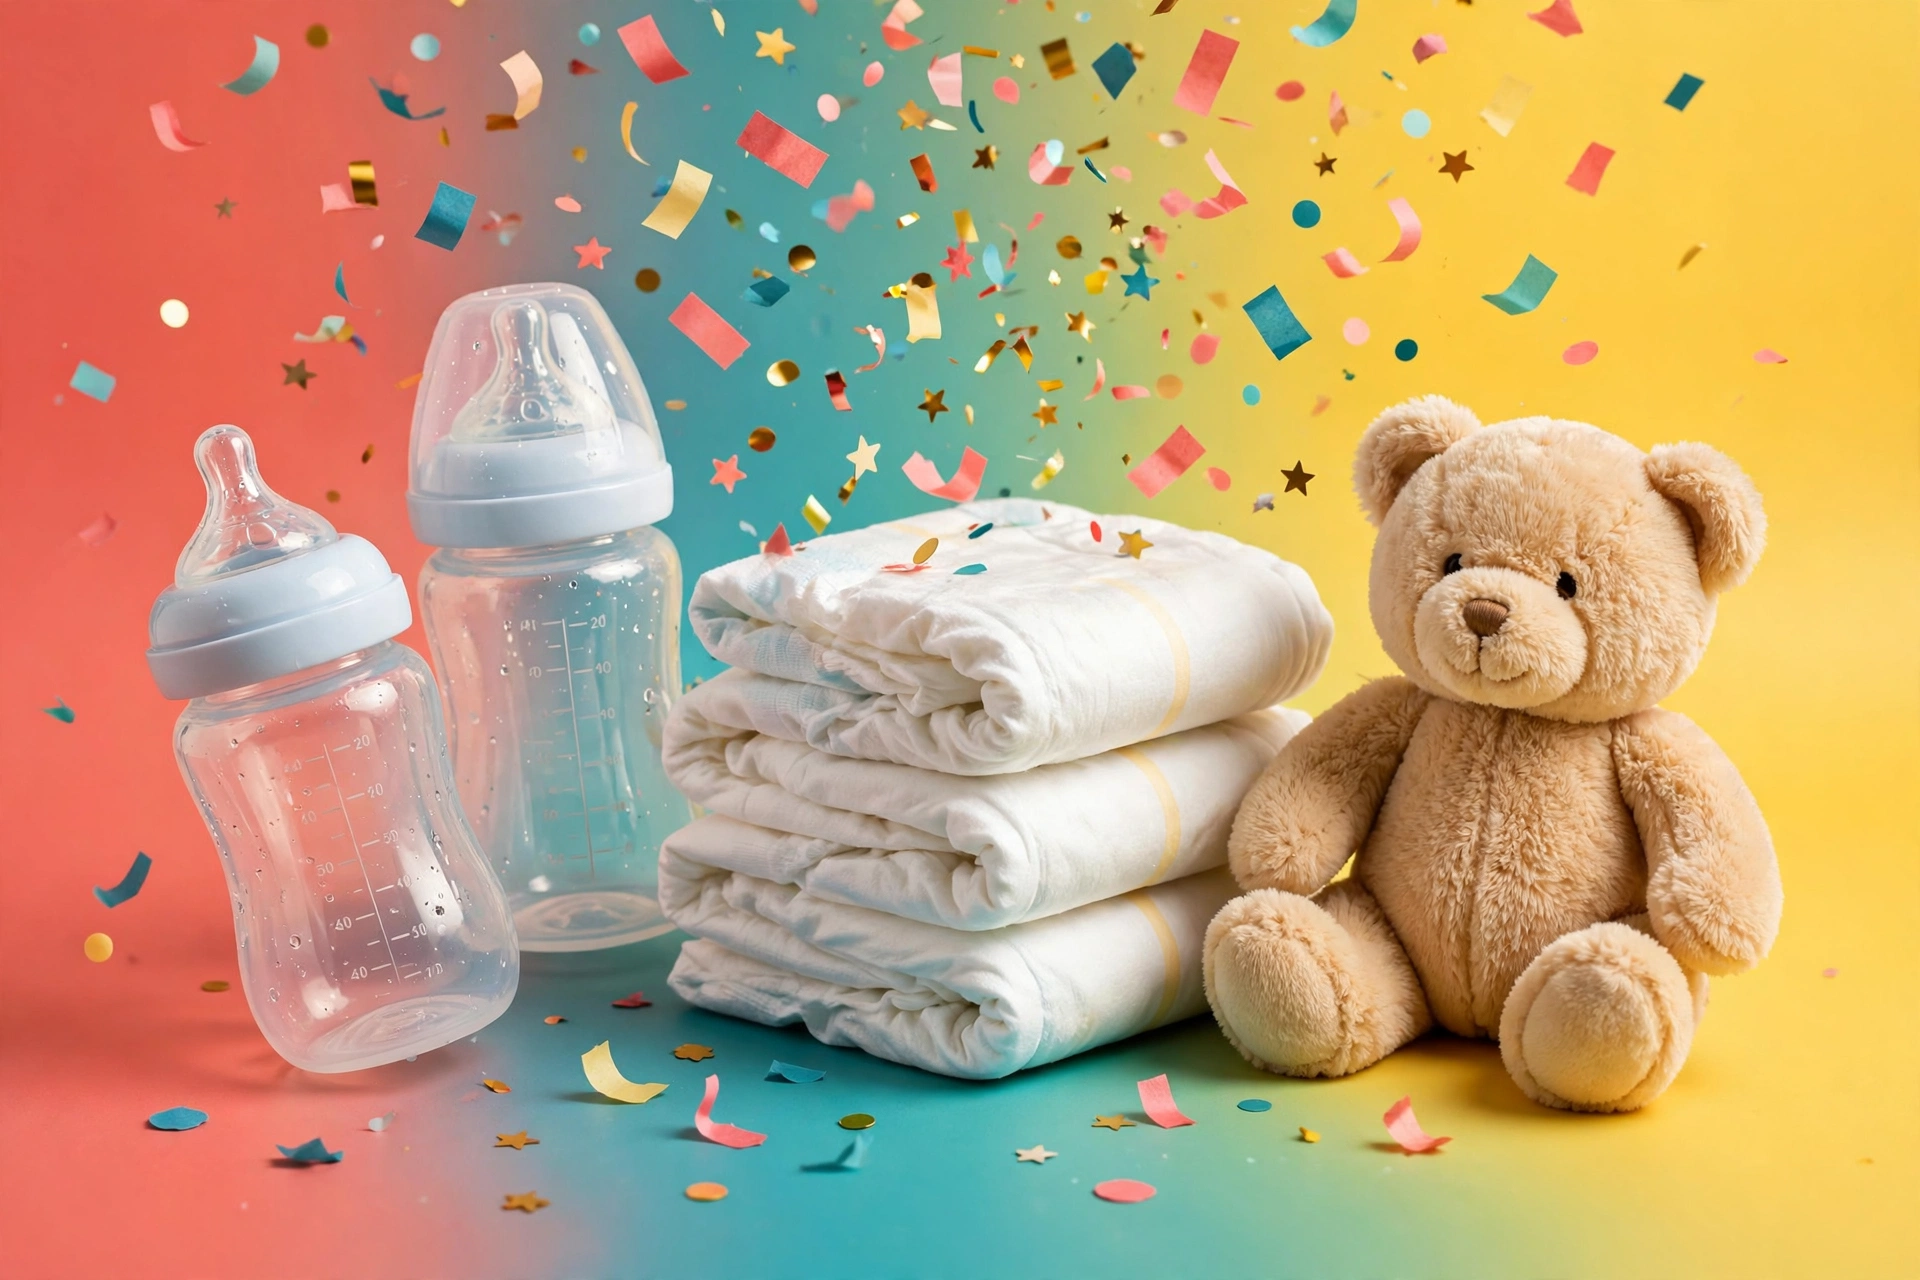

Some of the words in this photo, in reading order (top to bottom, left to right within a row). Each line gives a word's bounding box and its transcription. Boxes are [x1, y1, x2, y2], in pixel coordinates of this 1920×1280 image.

[591, 615, 606, 629] 20
[354, 734, 370, 750] 20
[316, 862, 334, 877] 50
